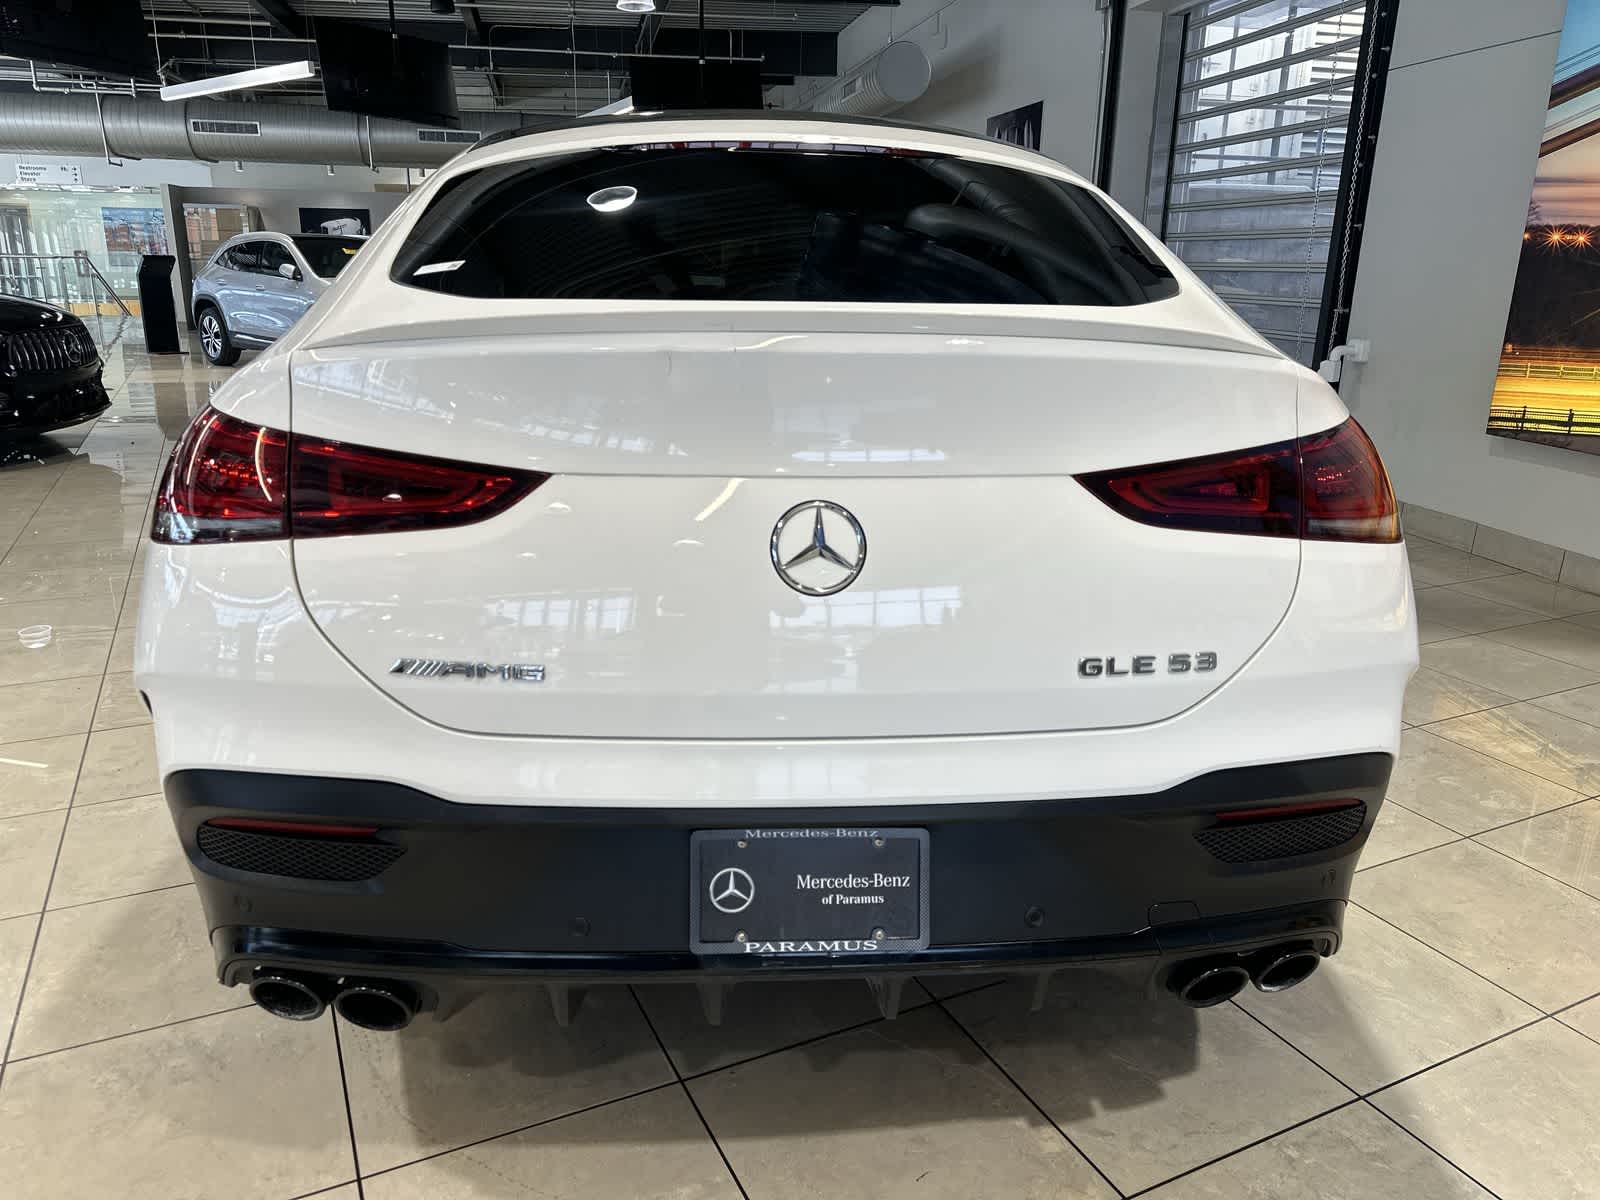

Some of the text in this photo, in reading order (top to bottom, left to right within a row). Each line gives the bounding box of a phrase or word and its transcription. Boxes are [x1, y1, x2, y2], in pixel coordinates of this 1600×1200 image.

[440, 660, 545, 681] AMG
[1078, 651, 1218, 677] GLE 53
[744, 829, 879, 839] Mercedes-Benz
[796, 873, 911, 890] Mercedes-Benz
[821, 894, 885, 905] of Paramus
[743, 940, 879, 953] PARAMUS
